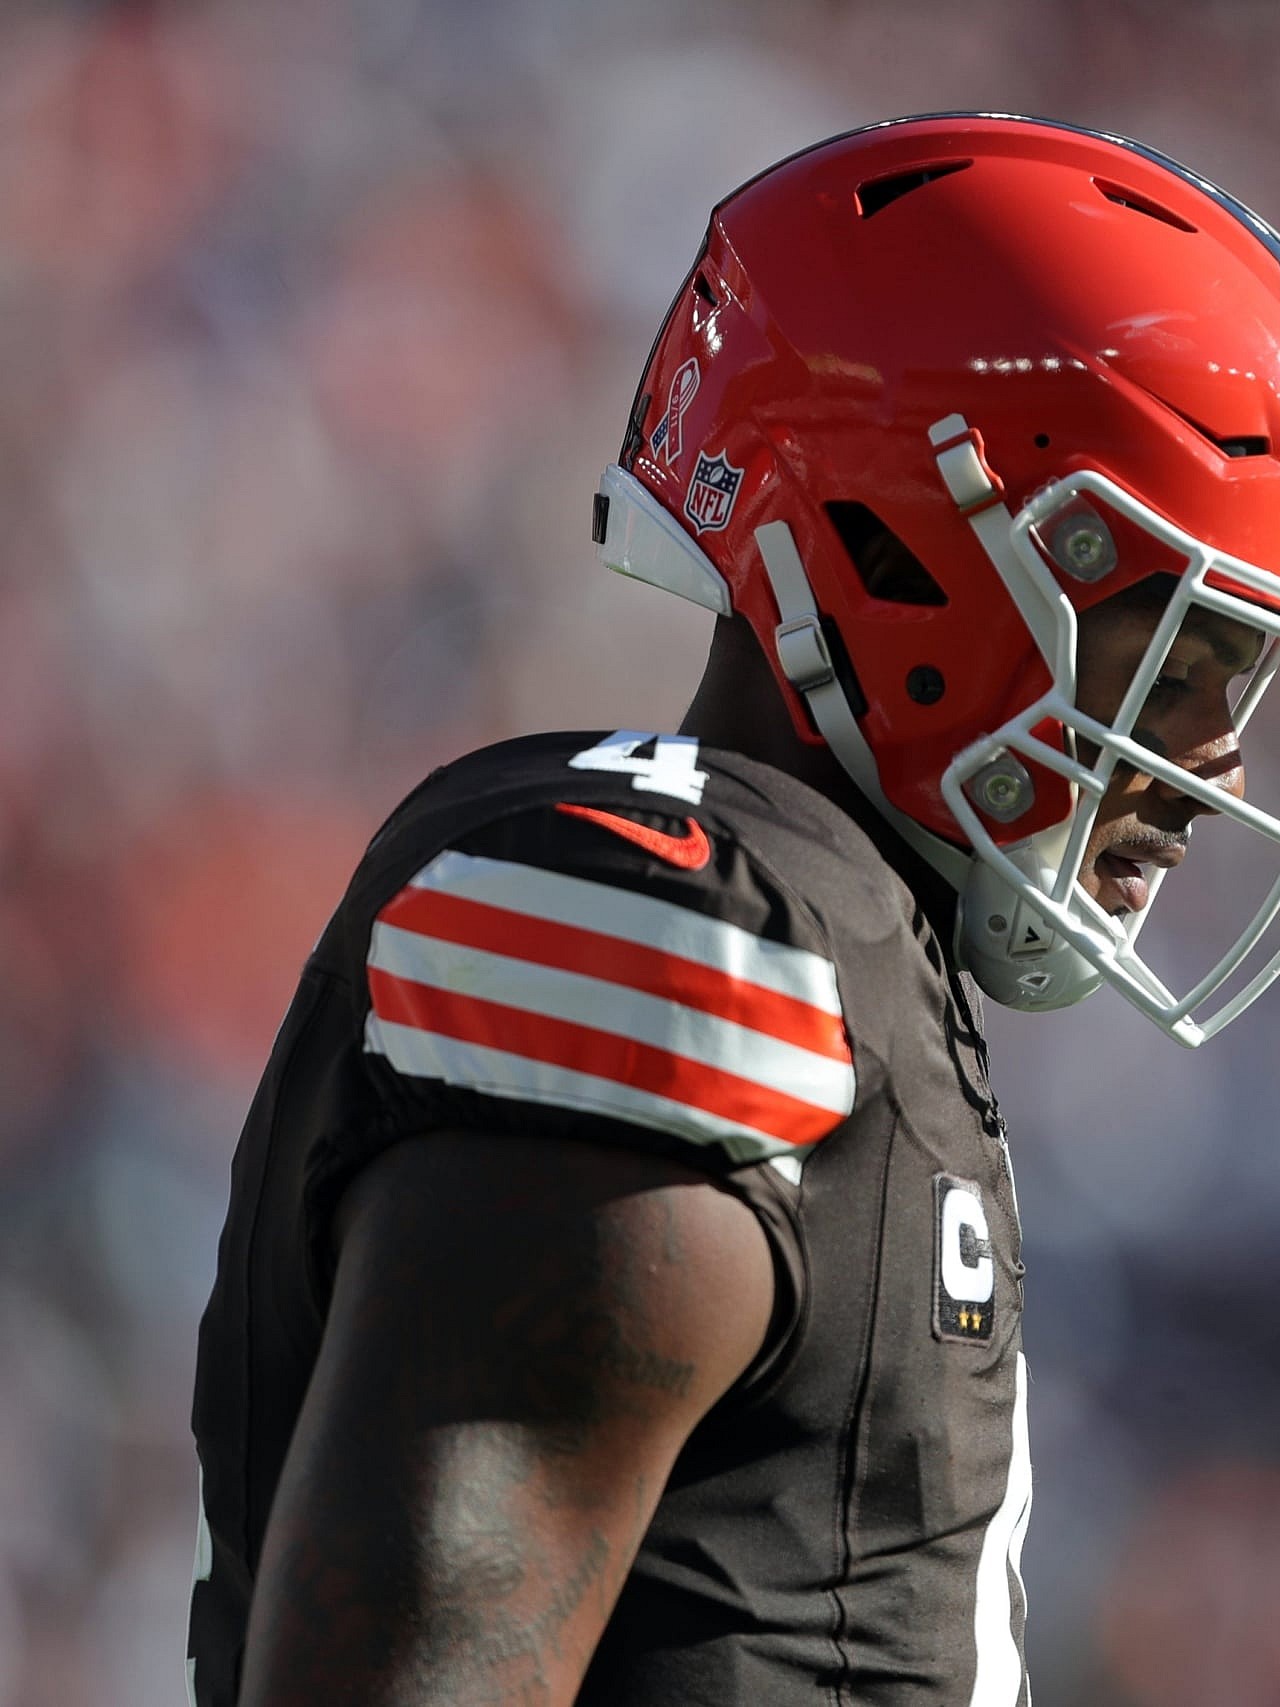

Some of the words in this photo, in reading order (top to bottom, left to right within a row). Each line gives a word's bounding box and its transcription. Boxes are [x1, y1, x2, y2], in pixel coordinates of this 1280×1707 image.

[670, 394, 679, 428] 9/11
[690, 482, 726, 522] NFL
[567, 730, 710, 805] 4
[941, 1188, 994, 1303] C
